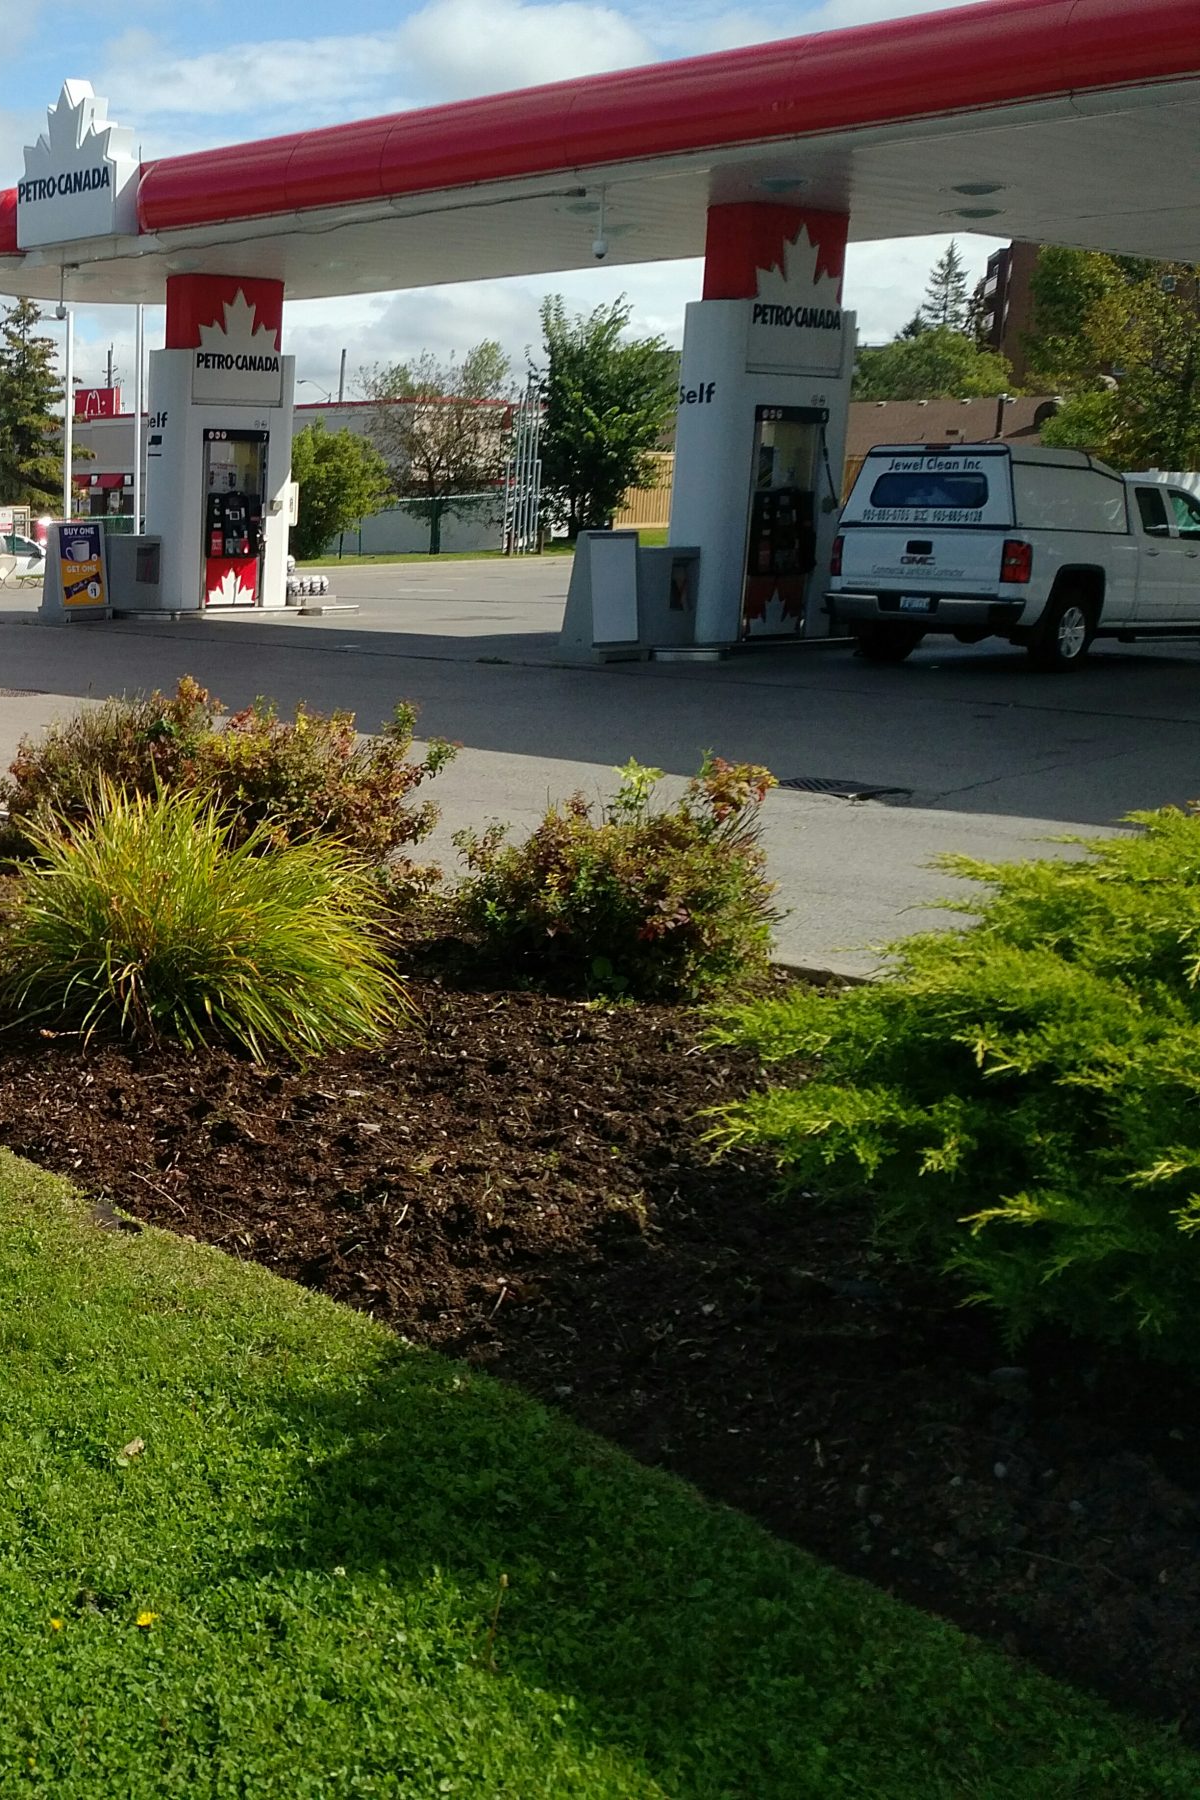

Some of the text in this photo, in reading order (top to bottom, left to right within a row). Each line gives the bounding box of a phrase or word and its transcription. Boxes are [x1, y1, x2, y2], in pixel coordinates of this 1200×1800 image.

[147, 410, 168, 428] elf
[888, 458, 924, 471] Jewel
[927, 457, 960, 470] Clean
[63, 527, 95, 536] BUY ONE
[900, 556, 935, 565] GMC
[66, 565, 80, 573] GET
